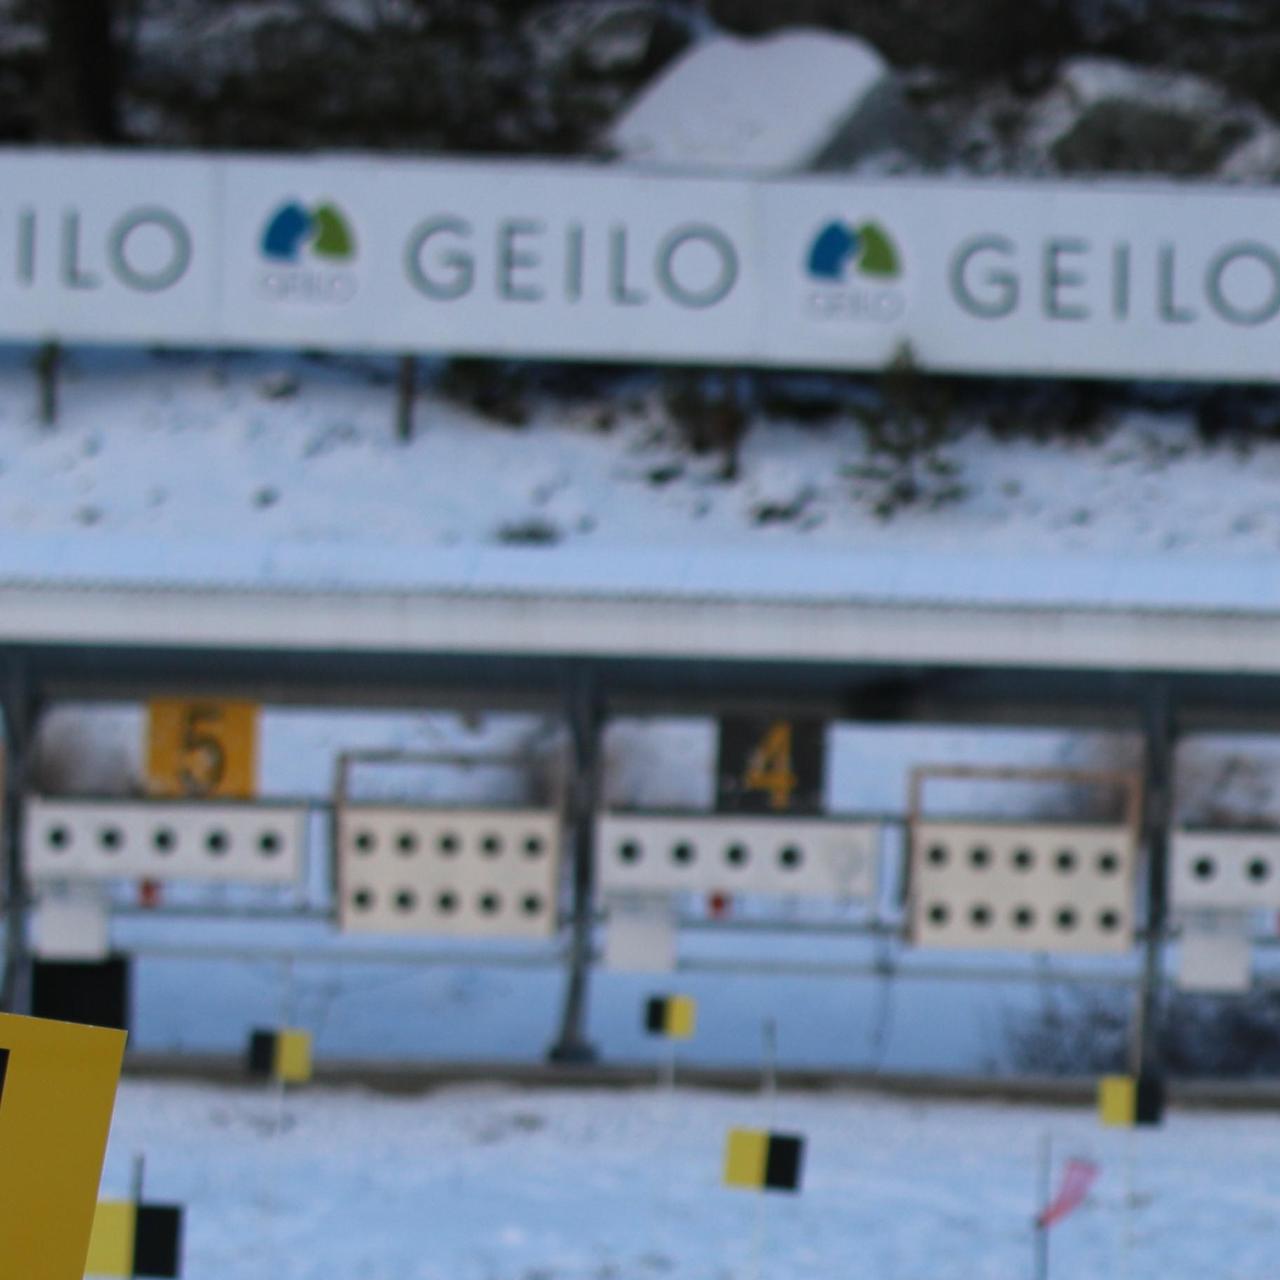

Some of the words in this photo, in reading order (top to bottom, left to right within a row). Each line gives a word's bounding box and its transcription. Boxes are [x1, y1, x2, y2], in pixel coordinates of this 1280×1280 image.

[404, 213, 741, 310] GEILO
[179, 704, 227, 798] 5
[743, 722, 798, 809] 4
